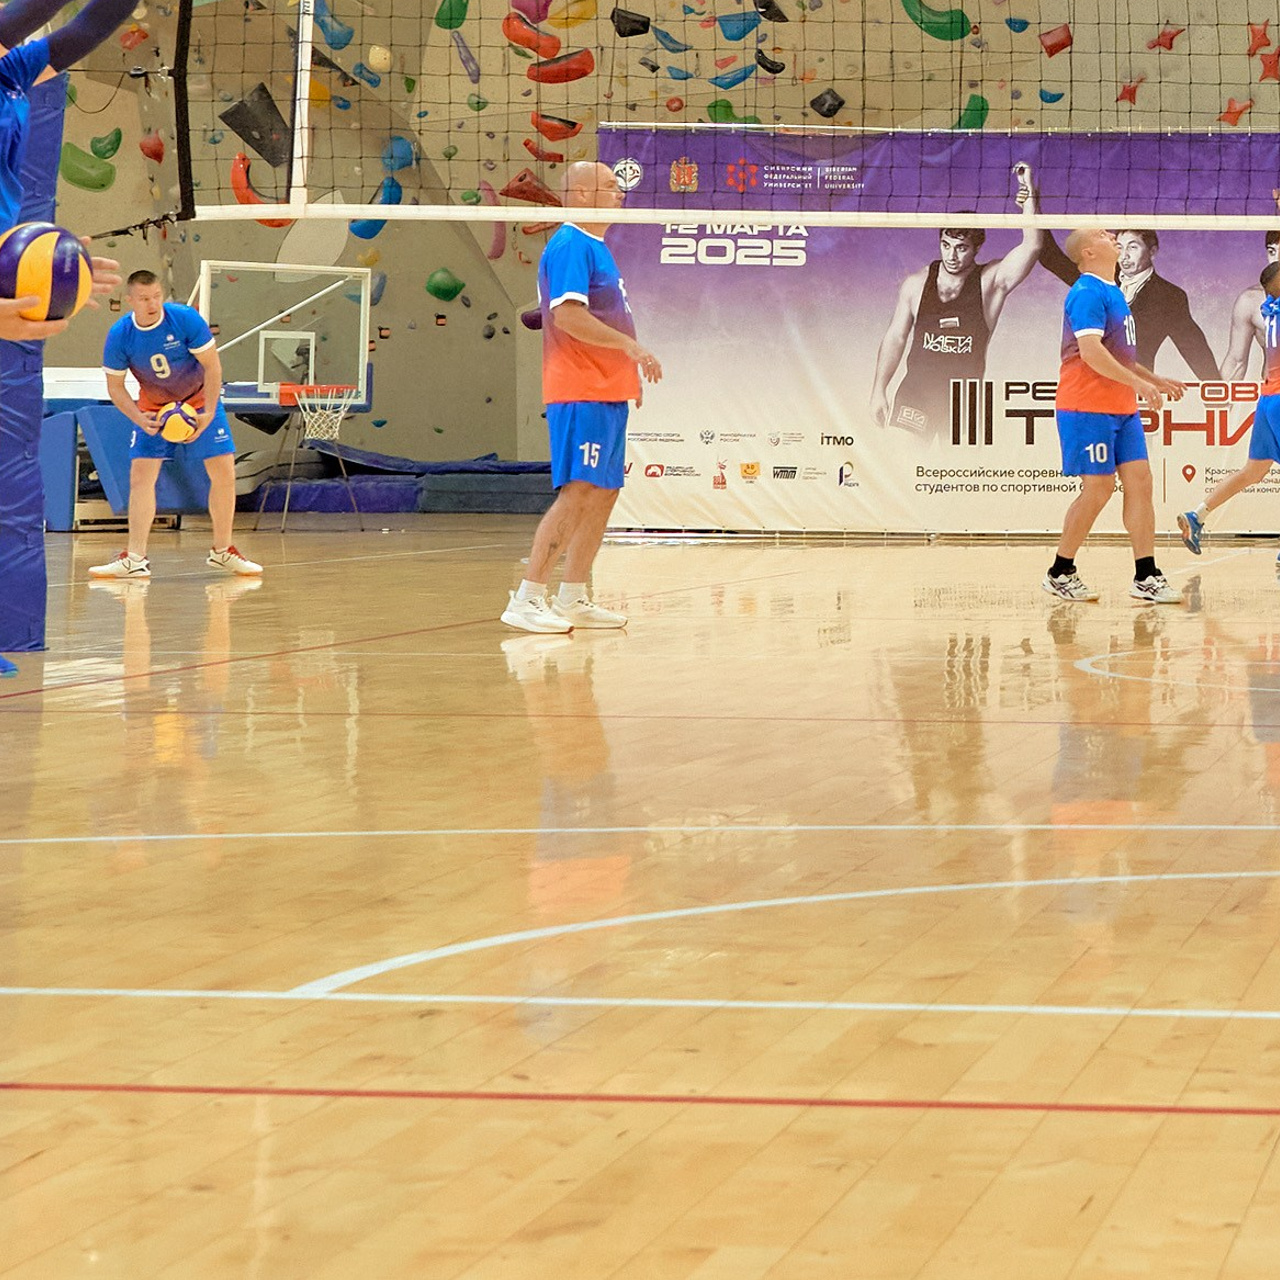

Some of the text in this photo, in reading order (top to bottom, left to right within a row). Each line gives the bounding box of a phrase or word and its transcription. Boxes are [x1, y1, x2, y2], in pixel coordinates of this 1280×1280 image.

[660, 237, 807, 266] 2025
[150, 353, 171, 379] 9
[579, 442, 601, 468] 15
[1085, 443, 1108, 464] 10
[916, 466, 1015, 483] Всероссийские
[915, 483, 980, 494] студентов
[1000, 482, 1077, 494] спортивной
